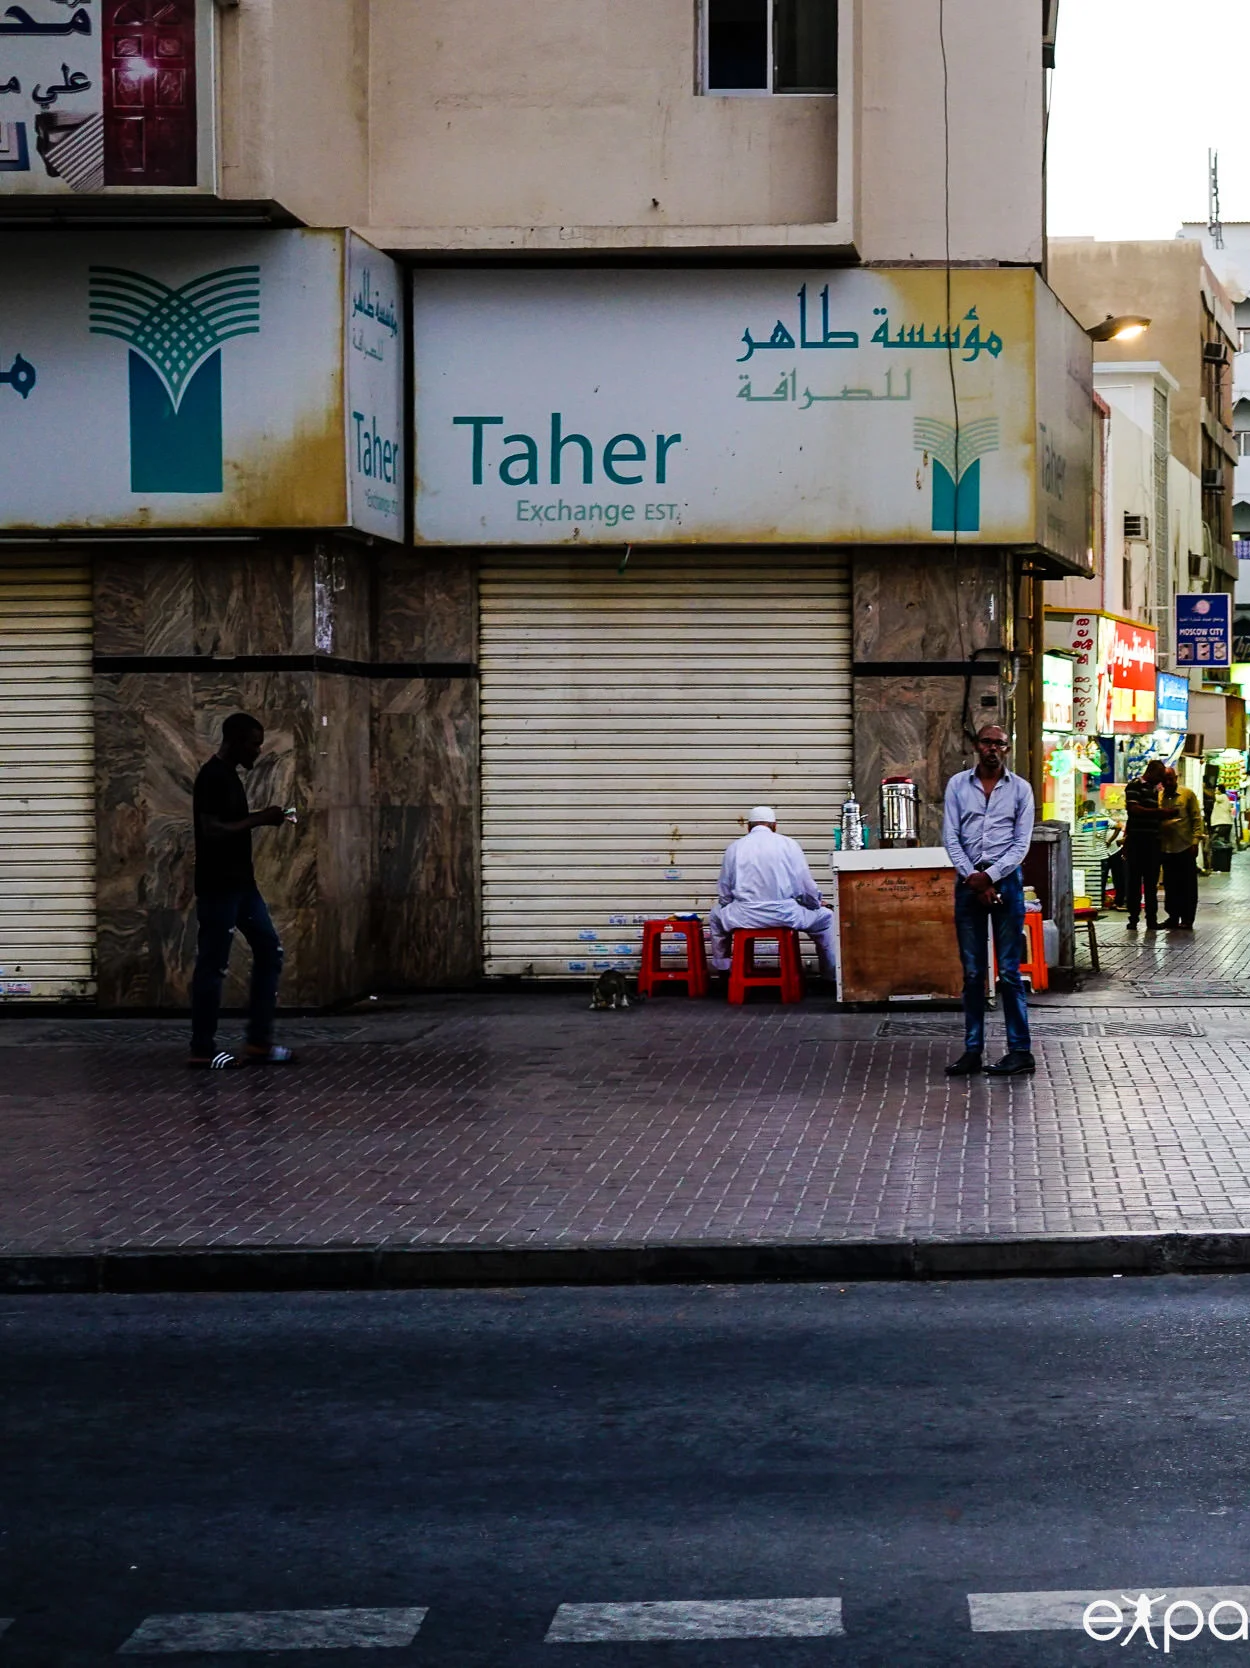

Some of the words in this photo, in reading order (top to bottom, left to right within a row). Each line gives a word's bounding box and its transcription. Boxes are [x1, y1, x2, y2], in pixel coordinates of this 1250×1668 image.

[32, 62, 92, 110] علي
[736, 282, 859, 362] طاهر
[870, 305, 1003, 362] مؤسسة
[736, 366, 912, 410] للصرافة
[352, 411, 399, 485] Taher
[453, 412, 682, 486] Taher
[517, 499, 635, 527] Exchange
[1179, 627, 1208, 636] MOSCOW
[1209, 627, 1225, 636] CITY
